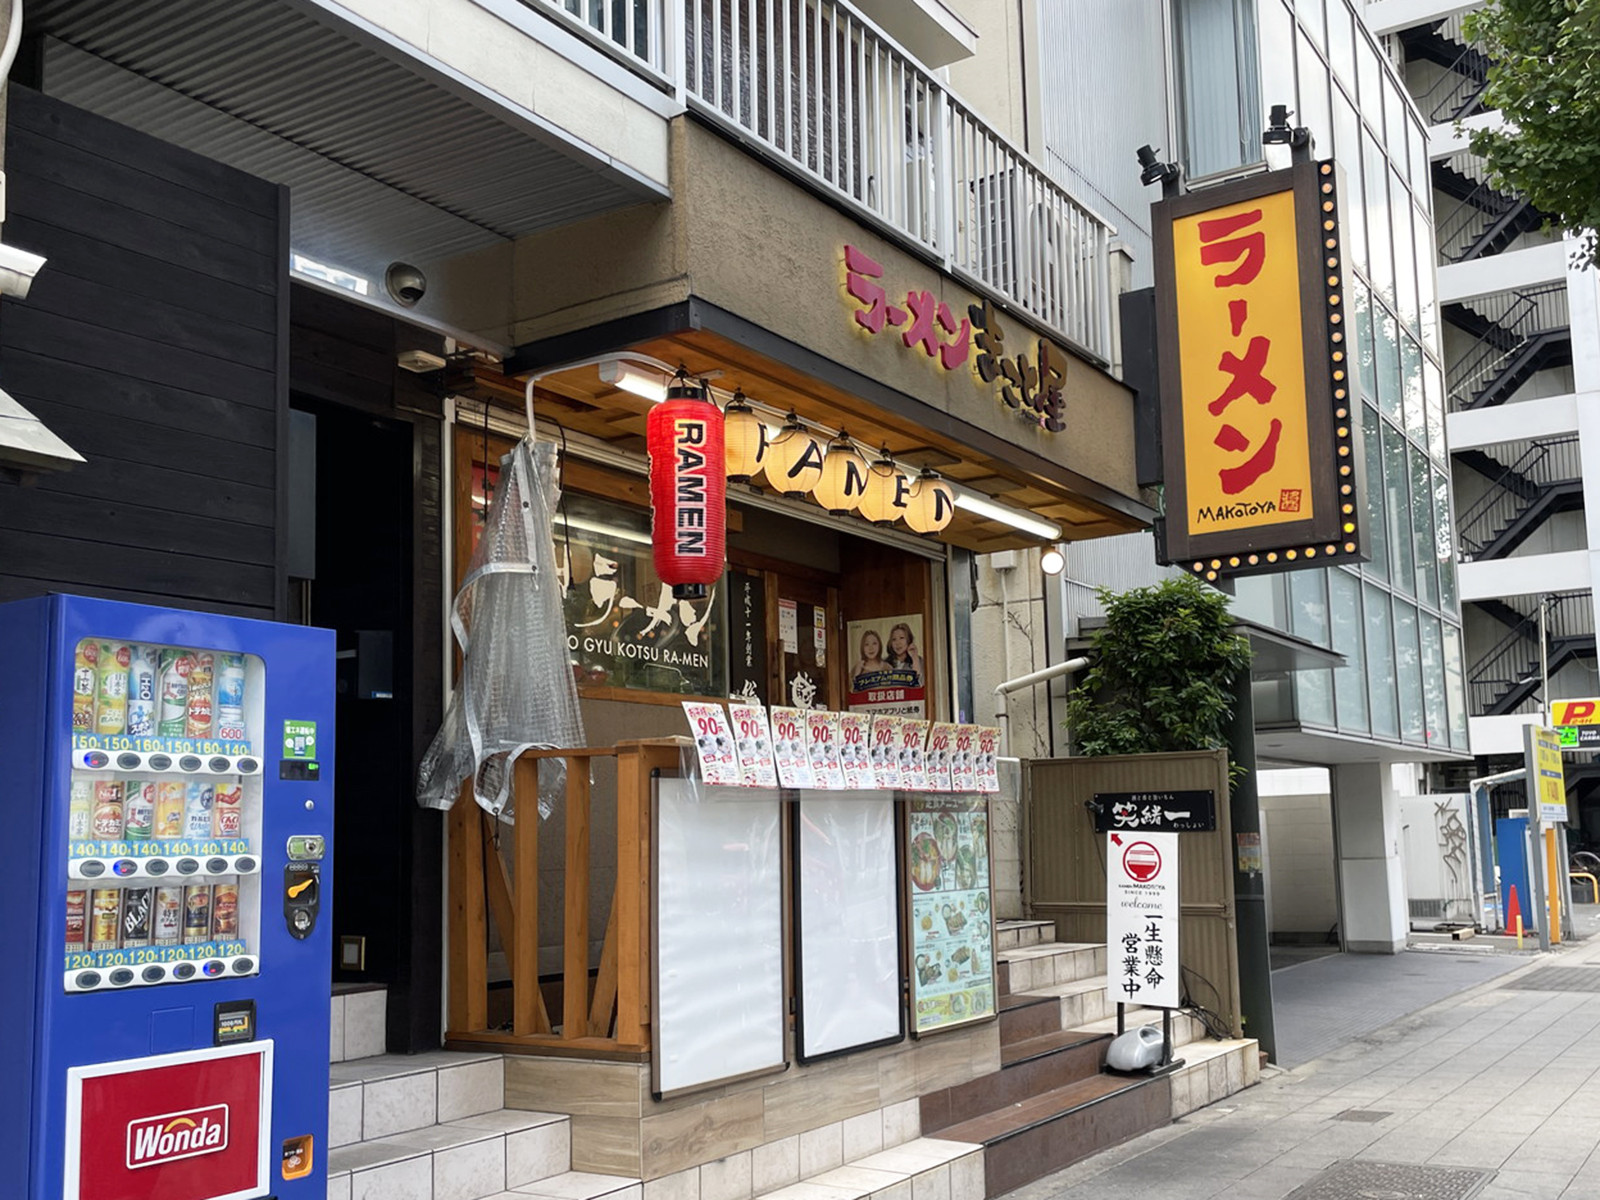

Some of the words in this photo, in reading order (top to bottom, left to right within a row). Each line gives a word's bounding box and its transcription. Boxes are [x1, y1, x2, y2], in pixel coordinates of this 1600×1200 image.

[843, 244, 971, 370] ラーメン
[1196, 208, 1282, 495] ラーメン
[675, 418, 707, 557] RAMEN
[584, 637, 613, 655] GYU
[617, 643, 659, 662] KOTSU
[663, 650, 709, 669] RA-MEN
[221, 728, 242, 739] 600
[1561, 701, 1595, 725] P
[1121, 896, 1163, 909] welcome
[1121, 932, 1142, 999] 営業中
[1144, 914, 1165, 989] 一生懸命
[133, 1117, 222, 1161] Wonda
